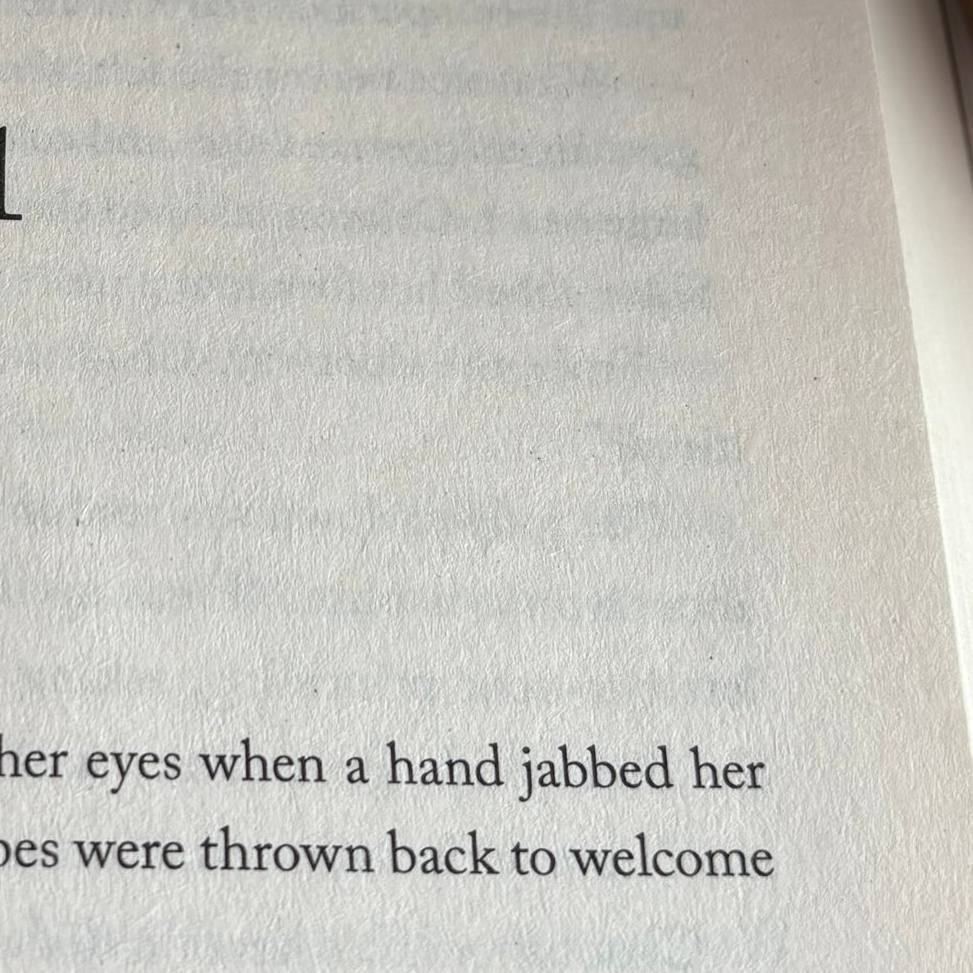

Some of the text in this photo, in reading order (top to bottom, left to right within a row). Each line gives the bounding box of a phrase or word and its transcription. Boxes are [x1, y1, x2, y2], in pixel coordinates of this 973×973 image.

[86, 751, 181, 794] eyes
[198, 737, 327, 783] when
[346, 757, 370, 784] a
[386, 740, 505, 787] hand
[518, 744, 674, 802] jabbed
[689, 745, 765, 790] her
[71, 841, 185, 870] were
[200, 825, 375, 874] thrown
[386, 828, 500, 875] back
[511, 842, 557, 876] to
[569, 832, 774, 879] welcome
